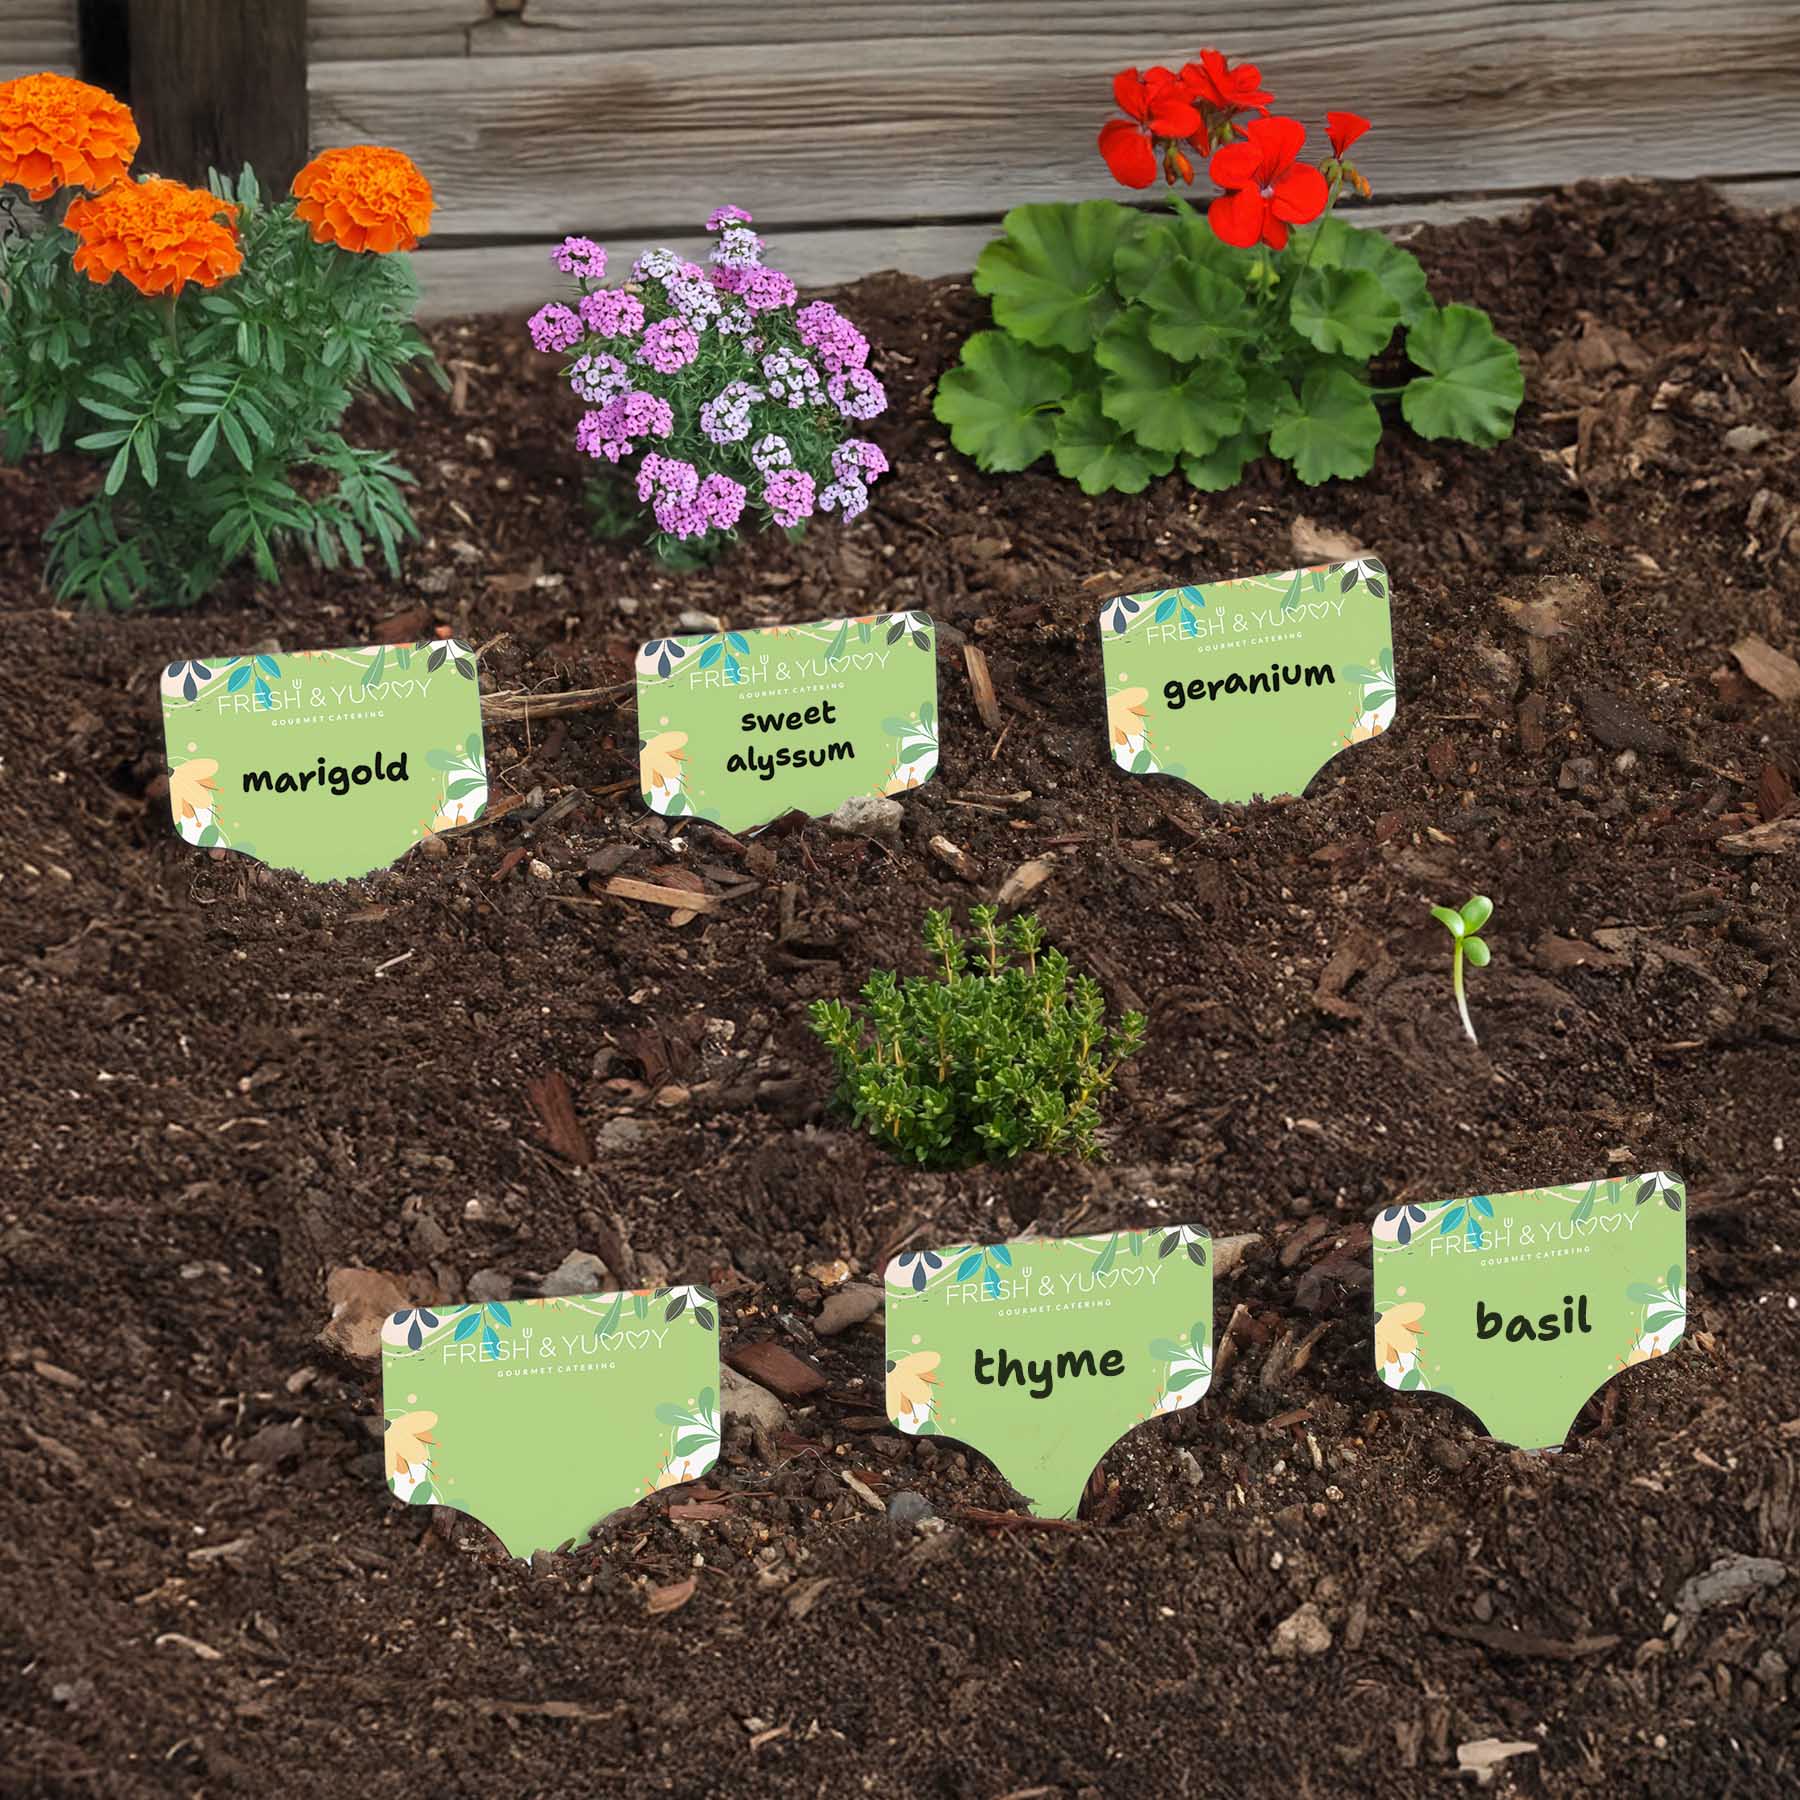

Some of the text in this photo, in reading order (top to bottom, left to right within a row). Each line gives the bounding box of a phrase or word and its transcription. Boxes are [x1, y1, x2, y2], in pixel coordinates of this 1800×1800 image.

[1146, 607, 1225, 645] FRESH
[1232, 614, 1248, 632] &
[1198, 631, 1303, 653] GOURMET CATERING
[690, 655, 769, 690] FRESH
[775, 663, 791, 680] &
[1164, 663, 1335, 709] geranium
[217, 679, 302, 715] FRESH
[310, 687, 327, 707] &
[739, 682, 845, 700] GOURMET CATERING
[271, 710, 385, 726] GOURMET CATERING
[742, 701, 836, 733] sweet
[243, 751, 409, 795] marigold
[727, 741, 855, 781] alyssum
[1430, 1217, 1513, 1256] FRESH
[1519, 1225, 1535, 1245] &
[1481, 1246, 1590, 1266] GOURMET CATERING
[946, 1266, 1032, 1305] FRESH
[1038, 1276, 1055, 1296] &
[998, 1299, 1112, 1316] GOURMET CATERING
[1477, 1295, 1592, 1342] basil
[442, 1328, 532, 1365] FRESH
[539, 1337, 557, 1358] &
[497, 1362, 616, 1377] GOURMET CATERING
[975, 1349, 1125, 1399] thyme
